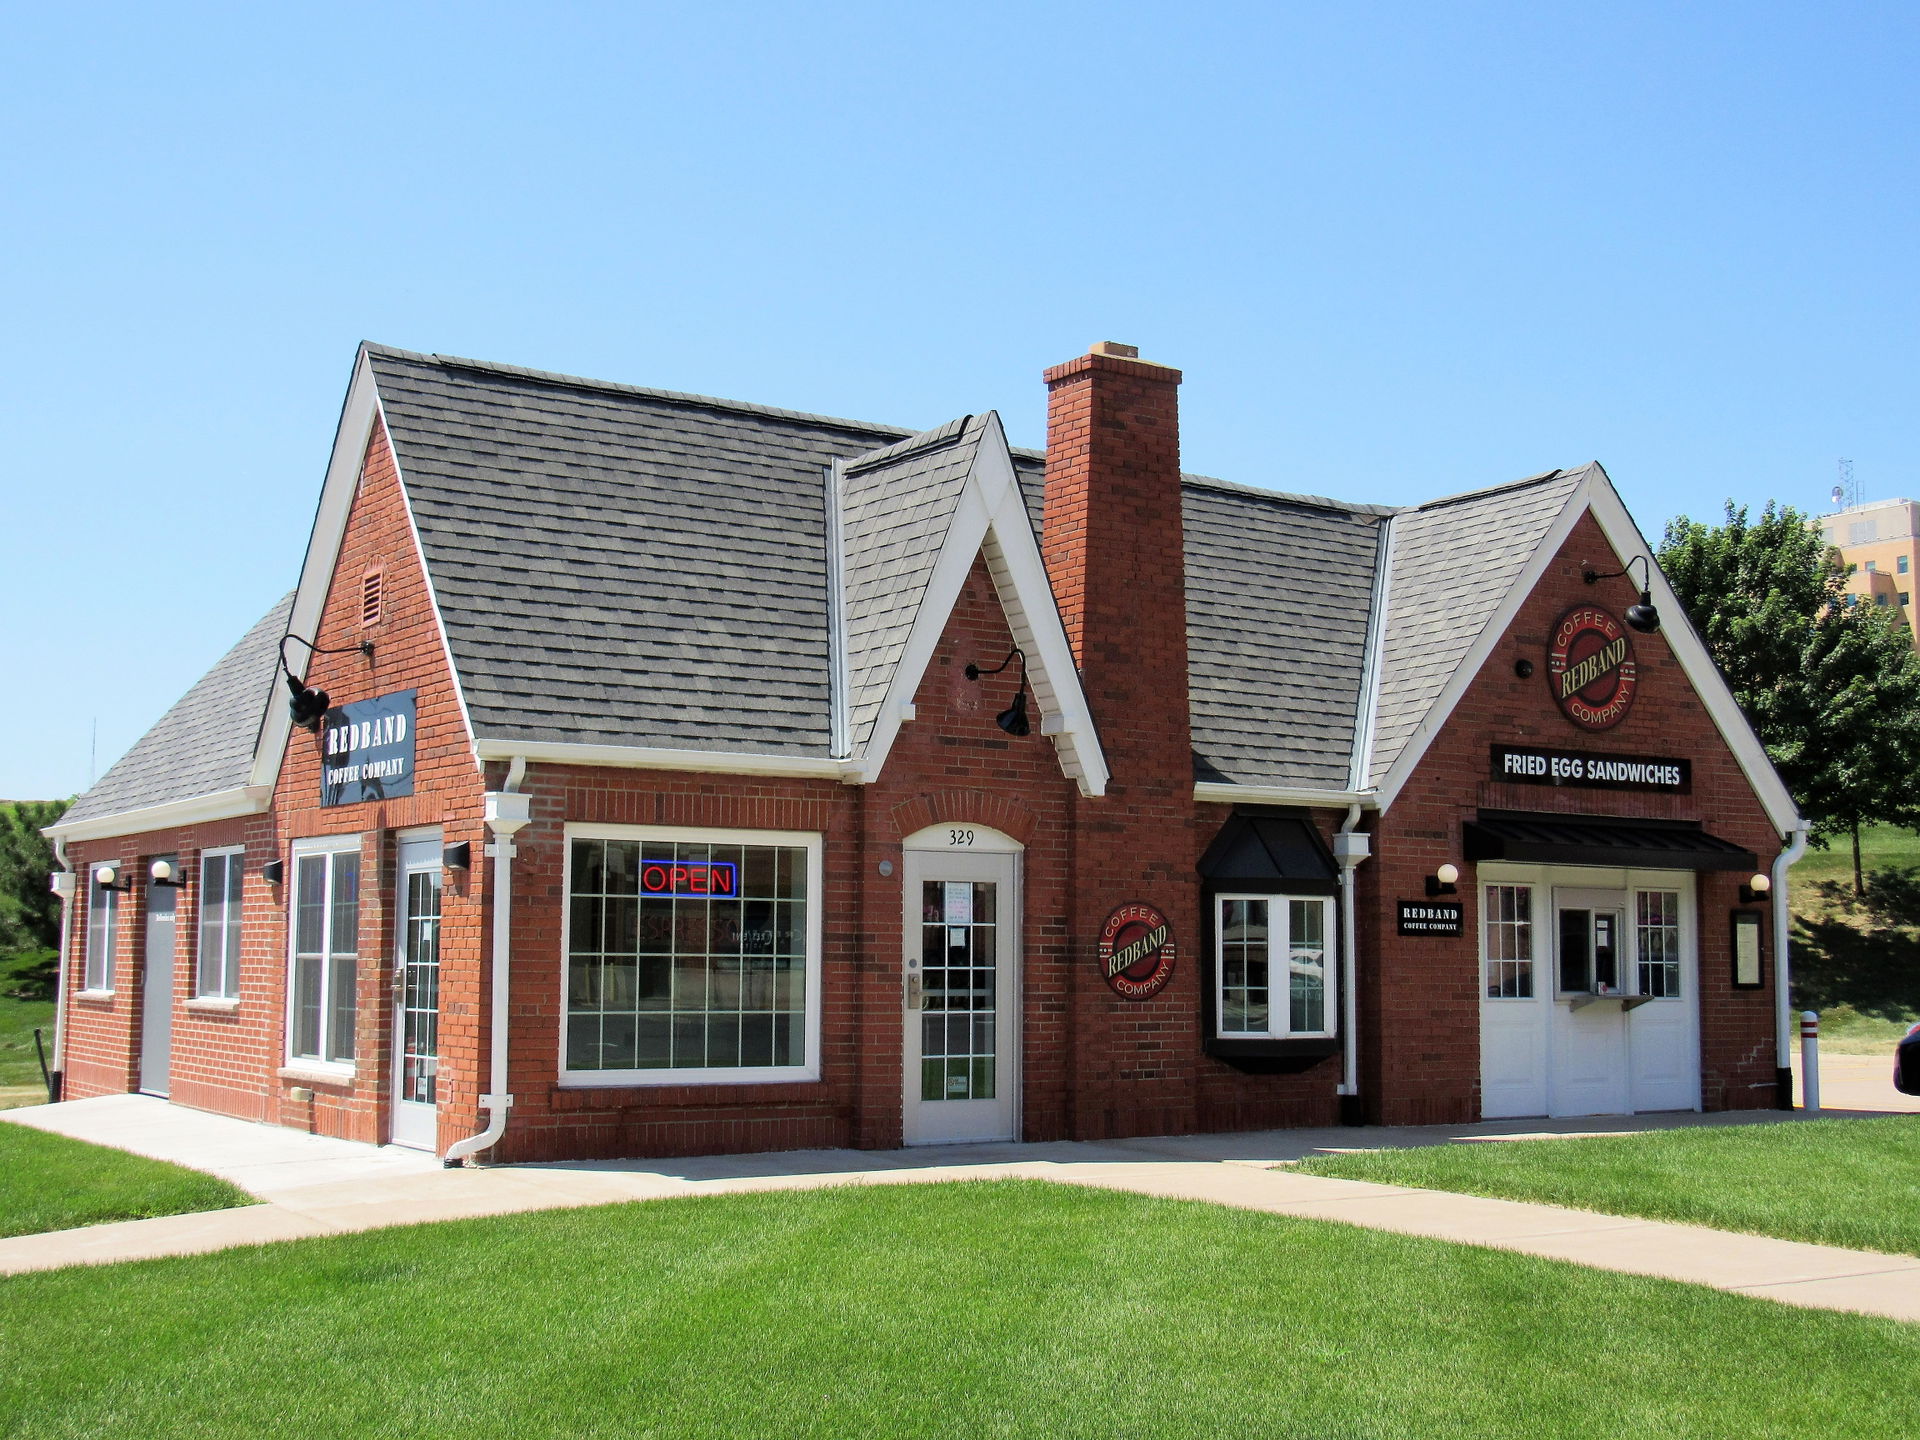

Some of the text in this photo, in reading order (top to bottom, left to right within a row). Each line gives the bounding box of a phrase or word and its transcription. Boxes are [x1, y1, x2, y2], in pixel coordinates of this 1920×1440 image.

[1557, 611, 1616, 647] COFFEE
[1561, 637, 1626, 699] REDBAND
[1571, 683, 1630, 724] COMPANY
[328, 713, 407, 756] REDBAND
[328, 757, 405, 786] COFFEE COMPANY
[1504, 753, 1680, 785] FRIED EGG SANDWICHES
[949, 829, 975, 846] 329
[642, 866, 731, 893] OPEN
[1105, 906, 1159, 938] COFFEE
[1403, 907, 1458, 920] REDBAND
[1403, 922, 1457, 931] COFFEE COMPANY
[1108, 924, 1167, 978] REDBAND
[1116, 960, 1169, 995] COMPANY
